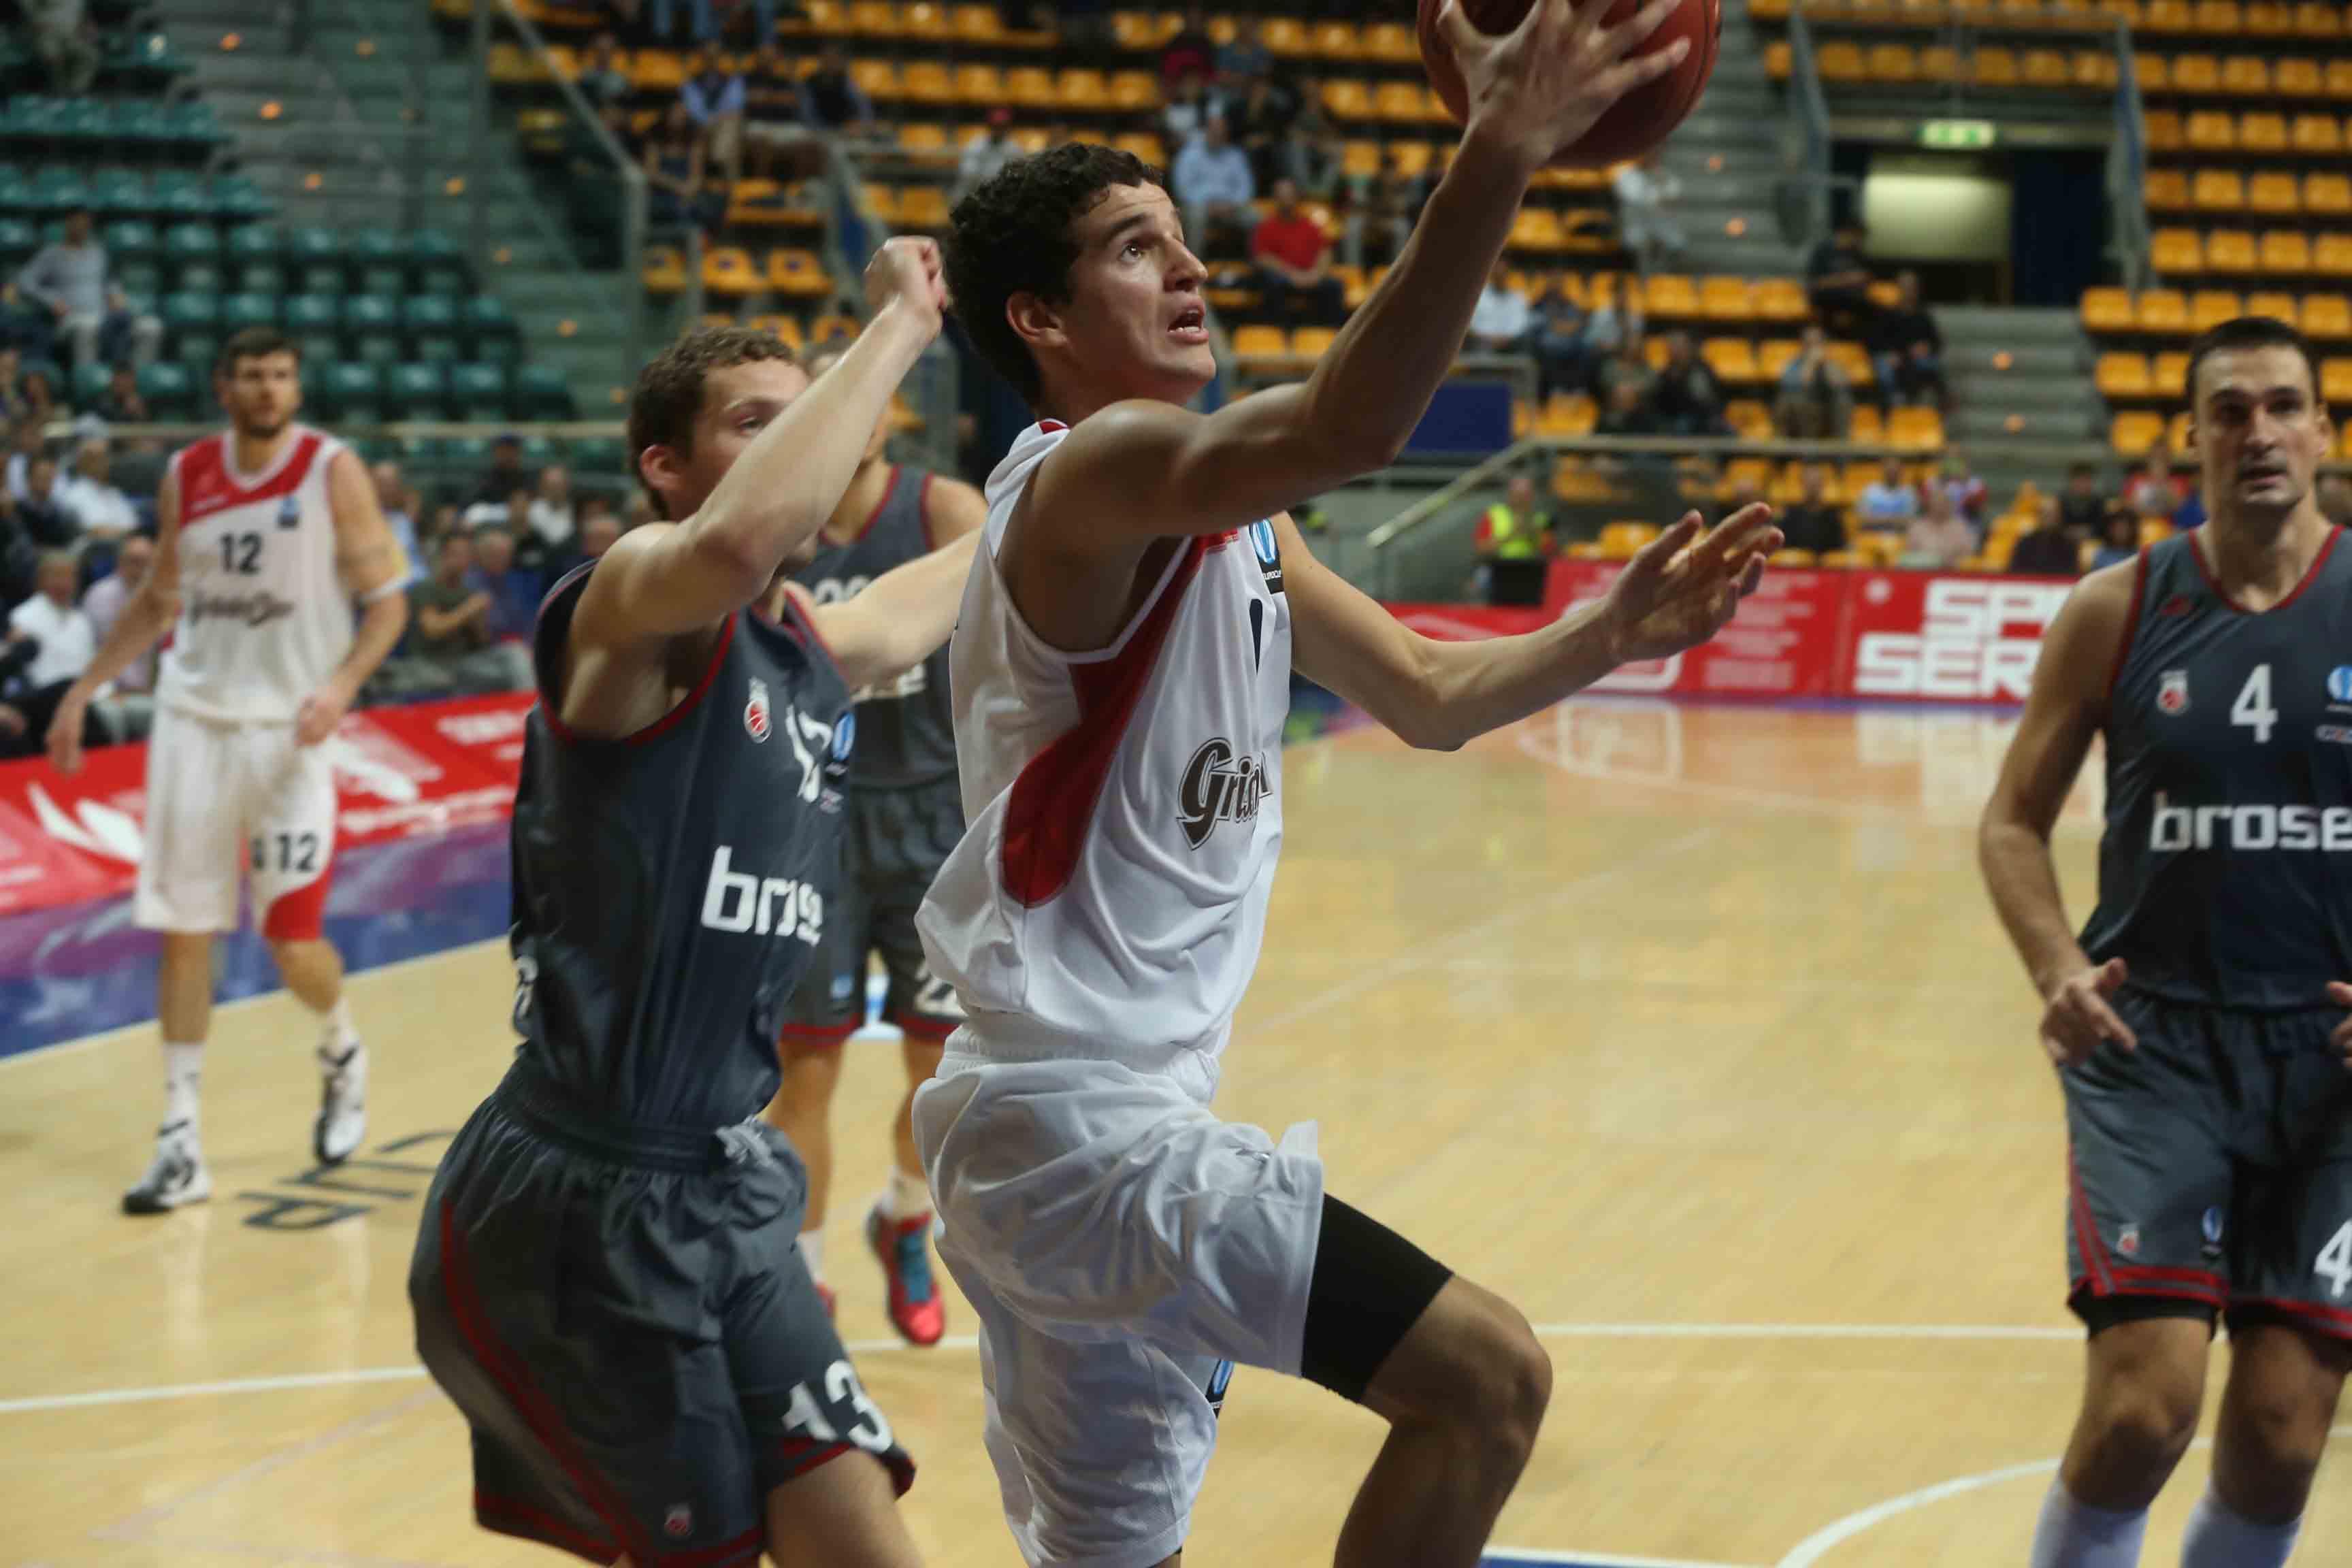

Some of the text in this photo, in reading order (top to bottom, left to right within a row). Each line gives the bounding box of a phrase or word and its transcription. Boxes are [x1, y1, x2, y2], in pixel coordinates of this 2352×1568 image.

[221, 532, 263, 575] 12
[2230, 664, 2278, 743] 4
[278, 833, 318, 871] 12
[2314, 1217, 2352, 1298] 4
[782, 1360, 894, 1454] 13
